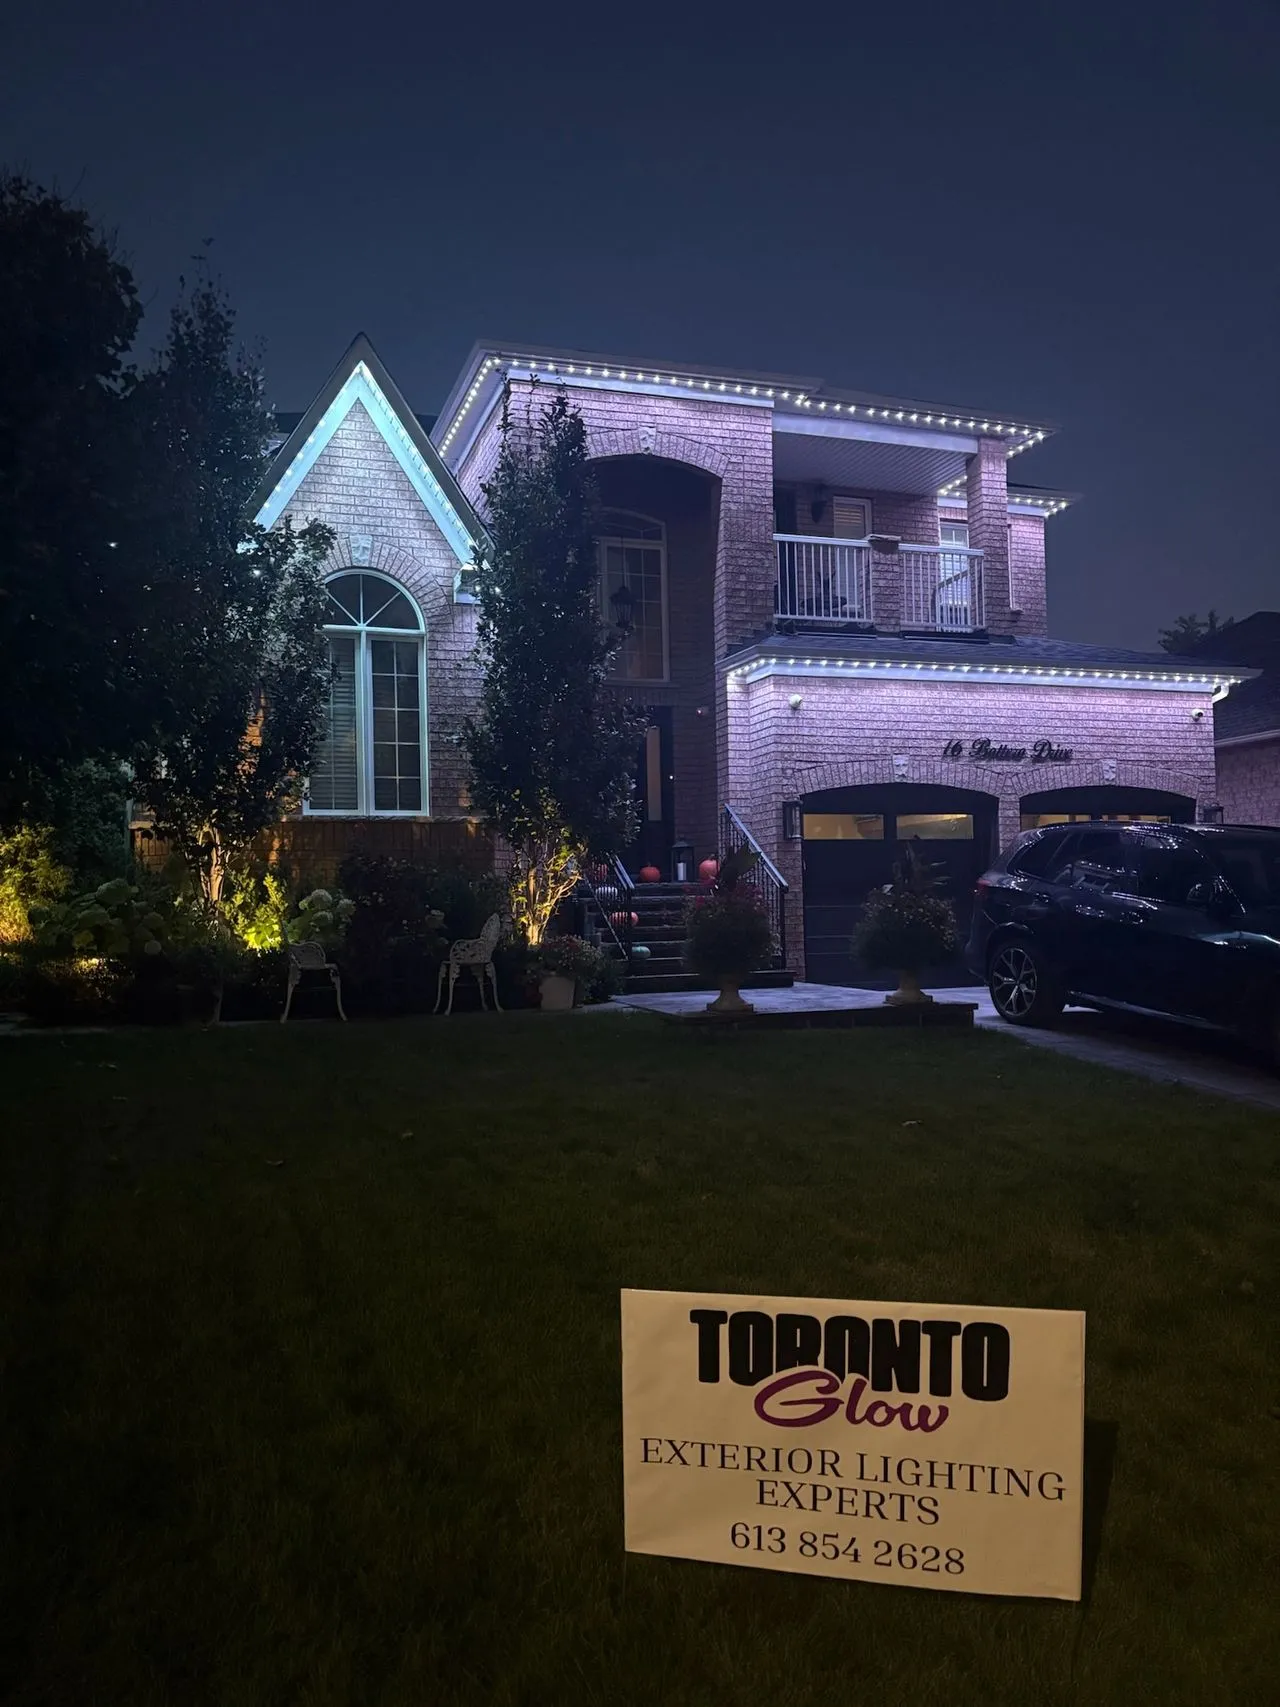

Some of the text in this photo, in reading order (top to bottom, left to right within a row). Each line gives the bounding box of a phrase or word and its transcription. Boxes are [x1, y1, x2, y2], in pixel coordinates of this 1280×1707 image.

[690, 1309, 1010, 1401] TORONTO
[754, 1370, 949, 1433] Glow
[640, 1437, 1067, 1501] EXTERIOR LIGHTING
[756, 1479, 940, 1525] EXPERTS
[731, 1522, 965, 1575] 613 854 2628
